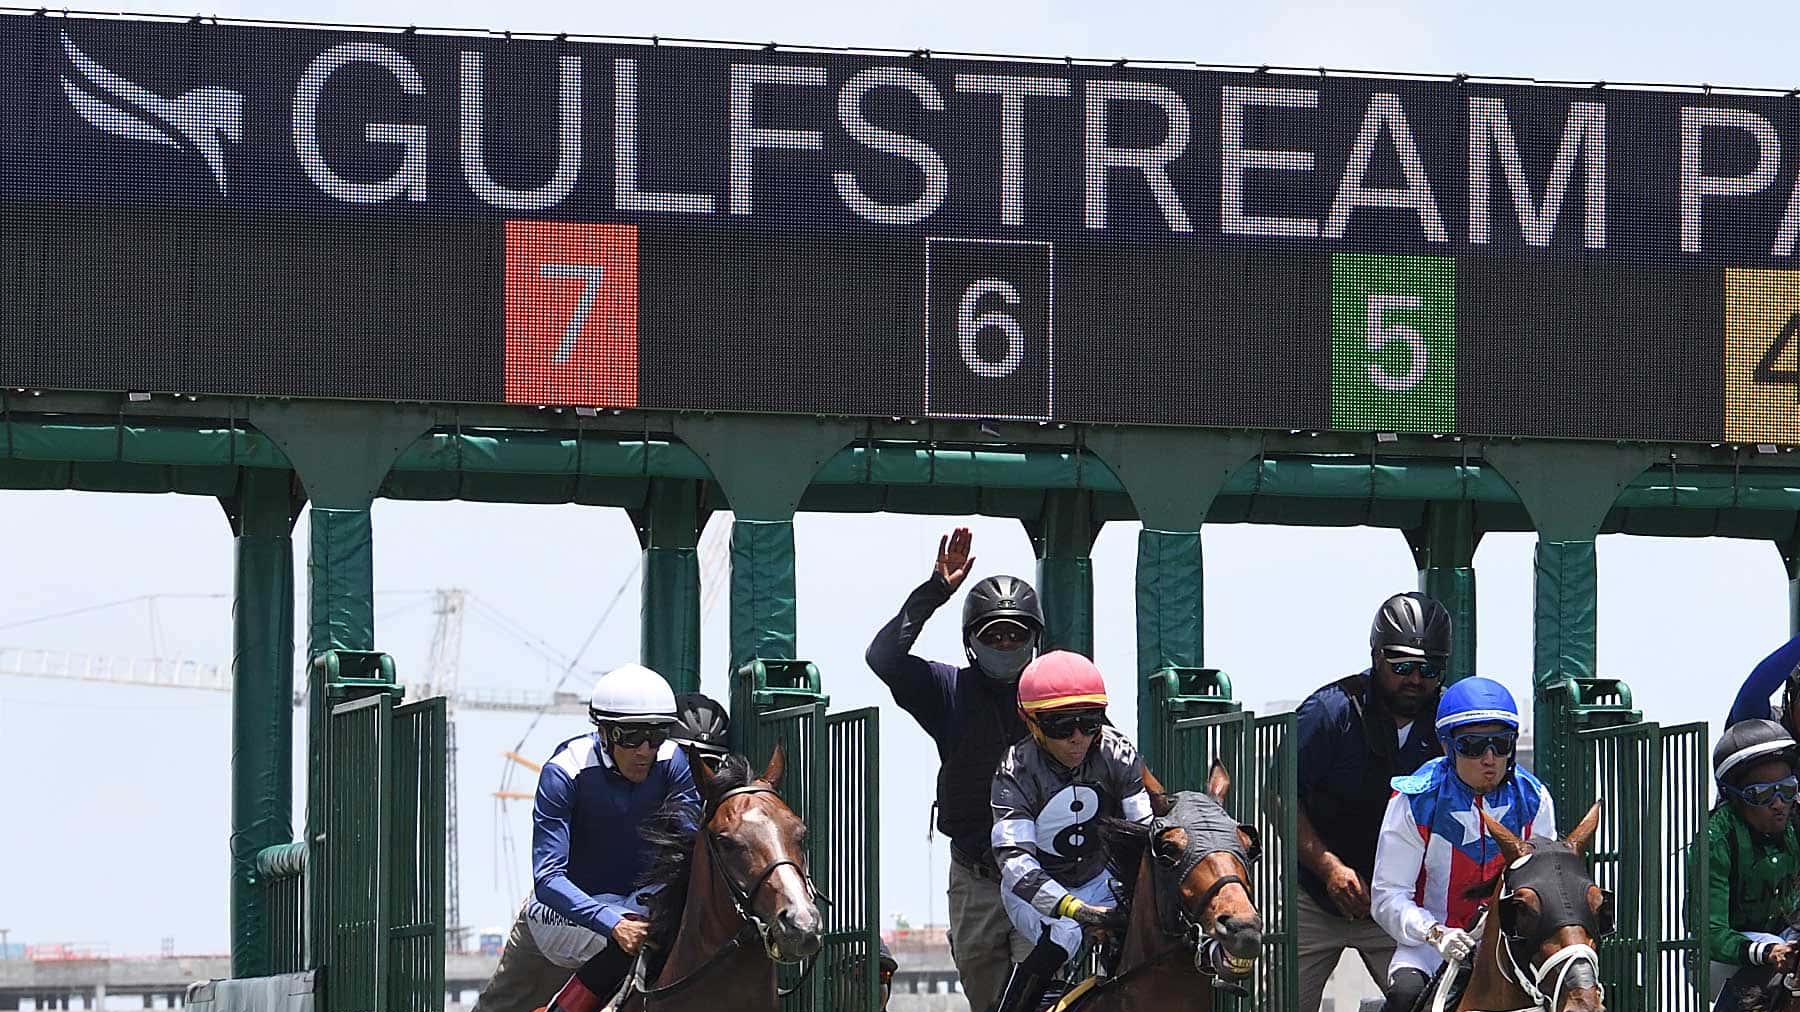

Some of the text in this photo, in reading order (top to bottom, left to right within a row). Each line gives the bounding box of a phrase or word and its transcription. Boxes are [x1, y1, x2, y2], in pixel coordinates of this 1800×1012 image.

[293, 42, 1606, 250] GULFSTREAM
[538, 264, 604, 363] 7
[957, 278, 1025, 378] 6
[1366, 295, 1428, 392] 5
